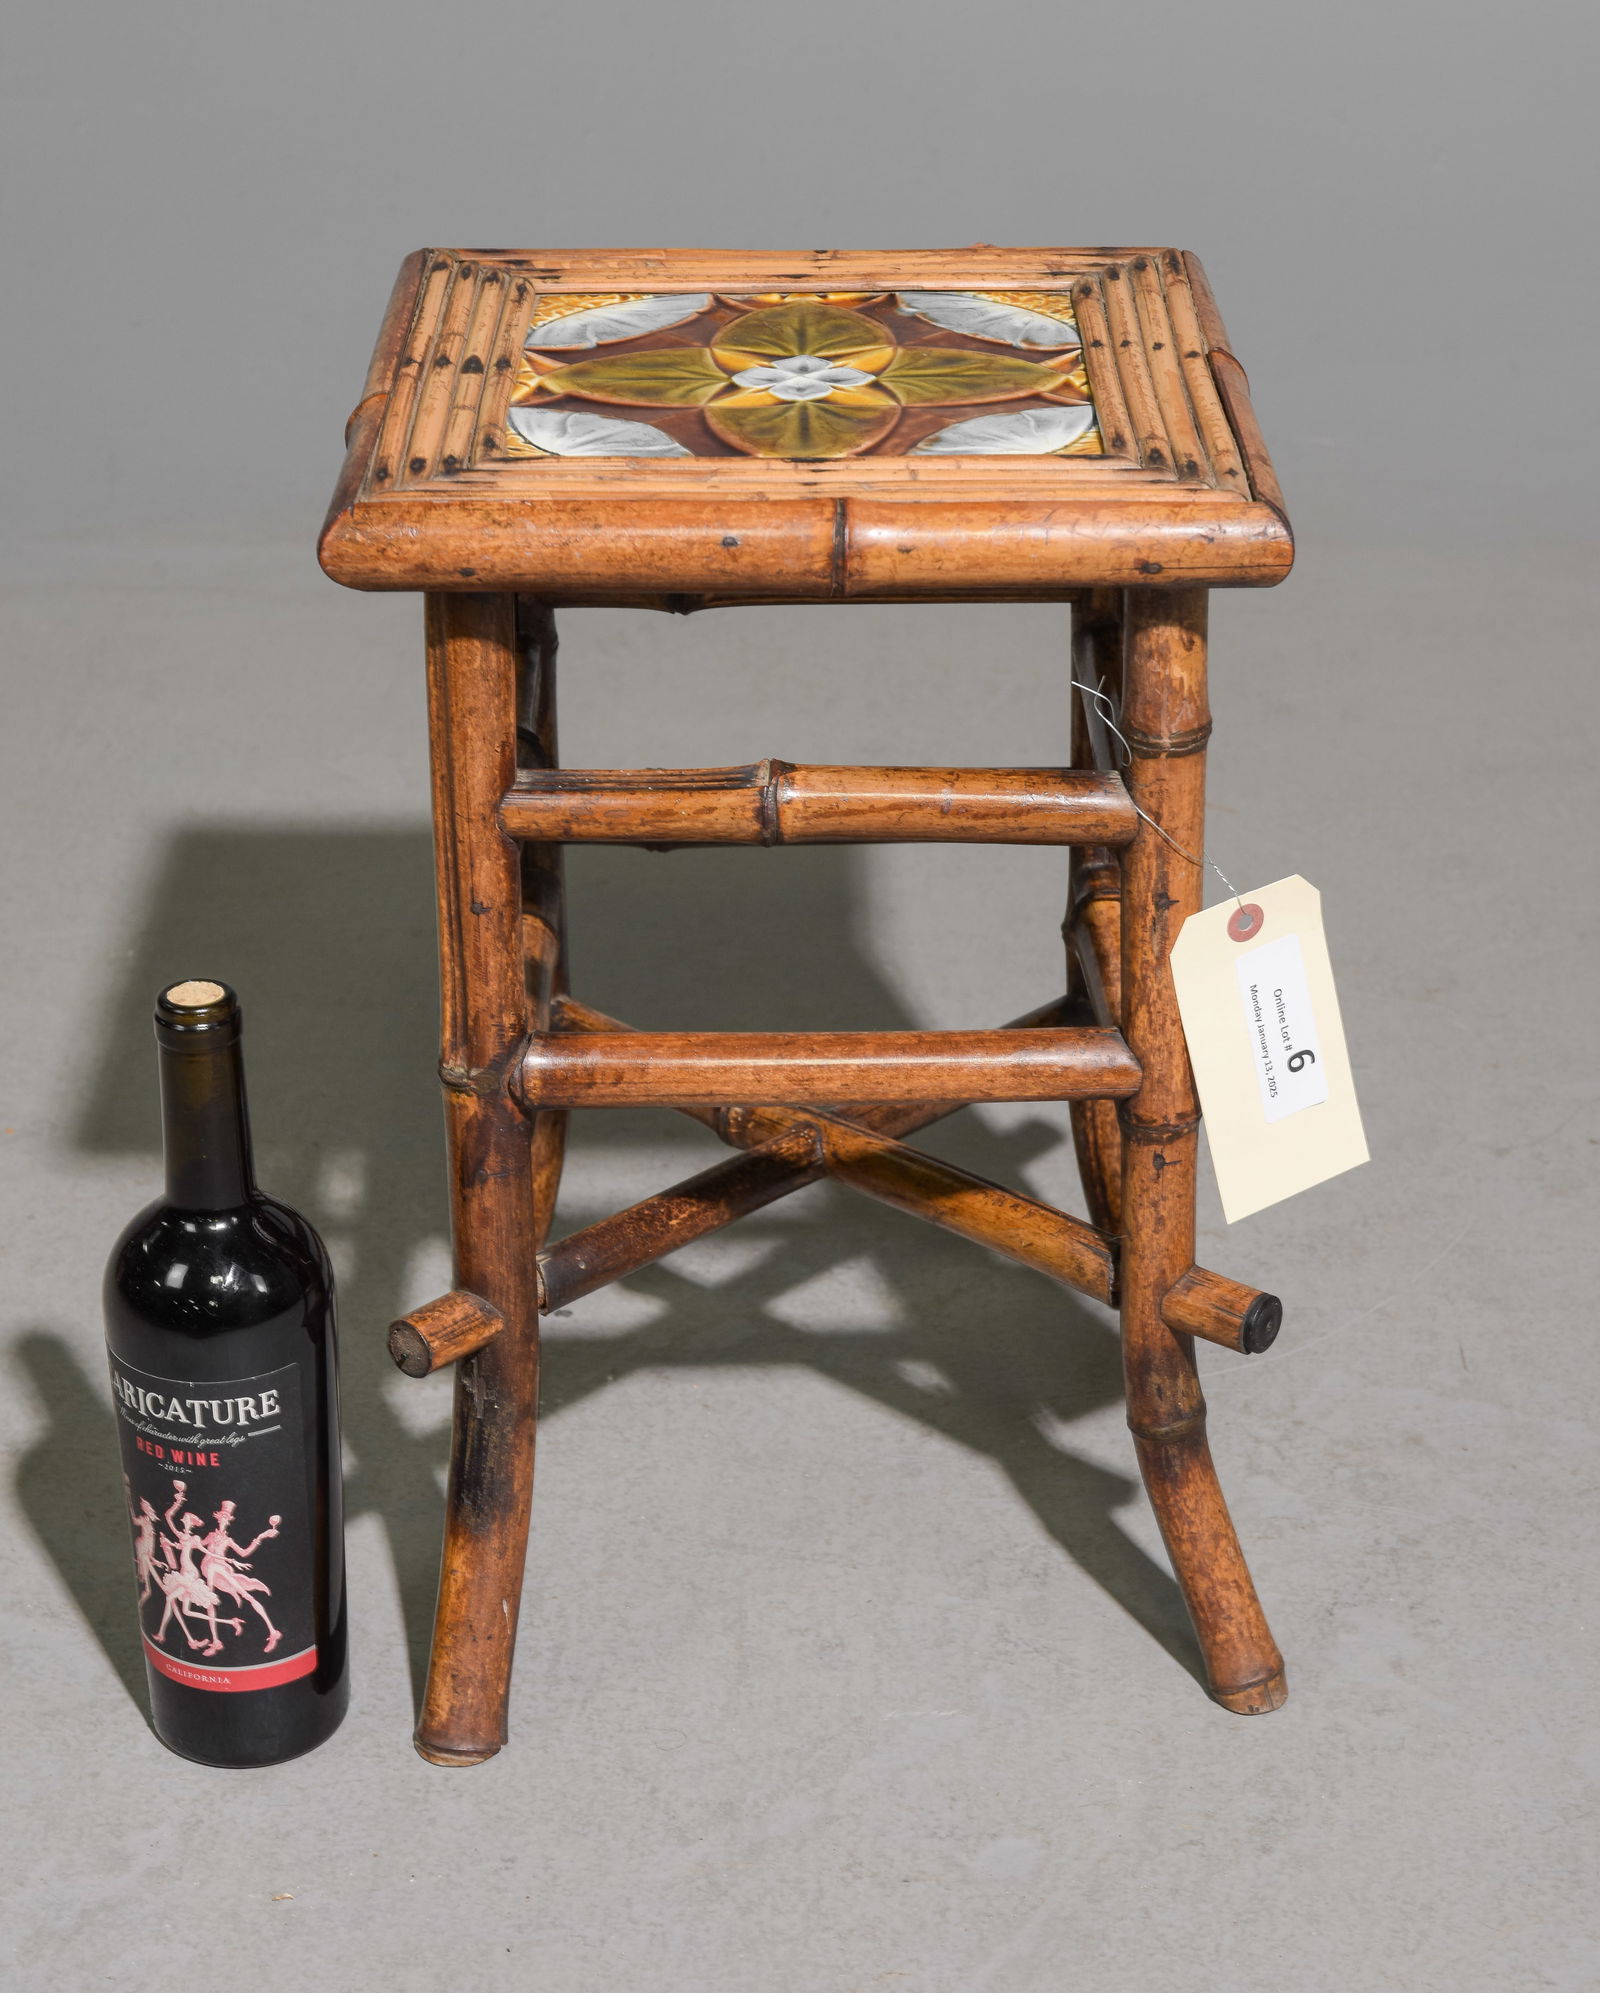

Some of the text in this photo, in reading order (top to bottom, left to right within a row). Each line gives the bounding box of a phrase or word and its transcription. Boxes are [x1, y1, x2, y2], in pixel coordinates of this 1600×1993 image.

[1249, 984, 1278, 1098] Monday January 13, 2025
[1273, 988, 1316, 1073] Online Lot # 6
[112, 1370, 281, 1428] ARICATURE
[136, 1436, 222, 1467] RED WINE
[178, 1432, 202, 1444] with
[197, 1435, 226, 1449] great
[225, 1431, 246, 1449] legs
[165, 1663, 231, 1685] CALIFORNIA
